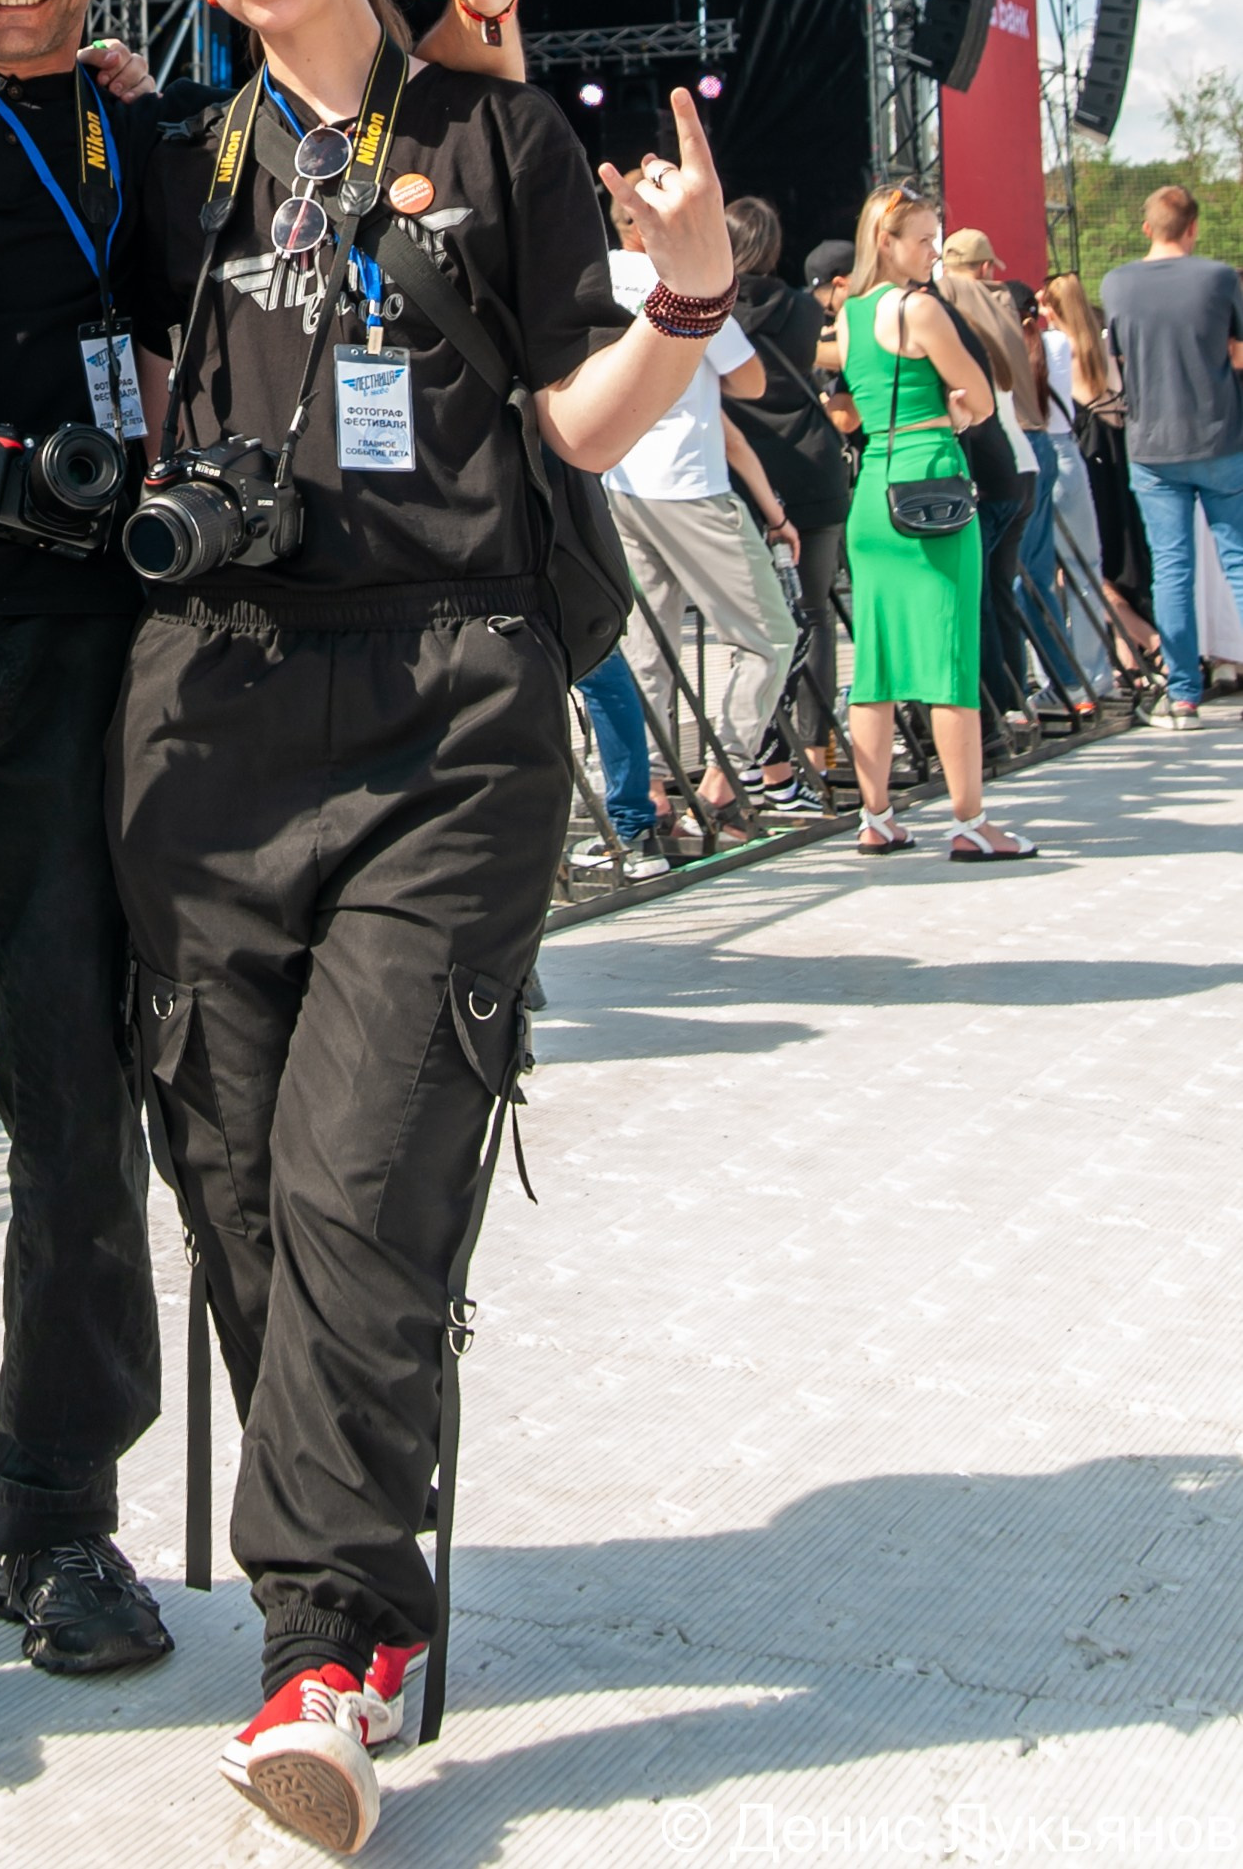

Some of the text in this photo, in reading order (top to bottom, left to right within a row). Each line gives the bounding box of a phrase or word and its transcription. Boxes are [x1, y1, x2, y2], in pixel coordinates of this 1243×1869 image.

[87, 110, 106, 170] Nikon
[356, 111, 385, 166] Nikon
[217, 129, 243, 183] Nikon
[346, 406, 404, 419] ФОТОГРАФ
[343, 417, 408, 430] ФЕСТИВАЛЯ
[358, 438, 397, 449] ГЛАВНОЕ
[345, 447, 410, 458] СОБЫТИЕ ЛЕТА
[194, 463, 221, 477] Nikon
